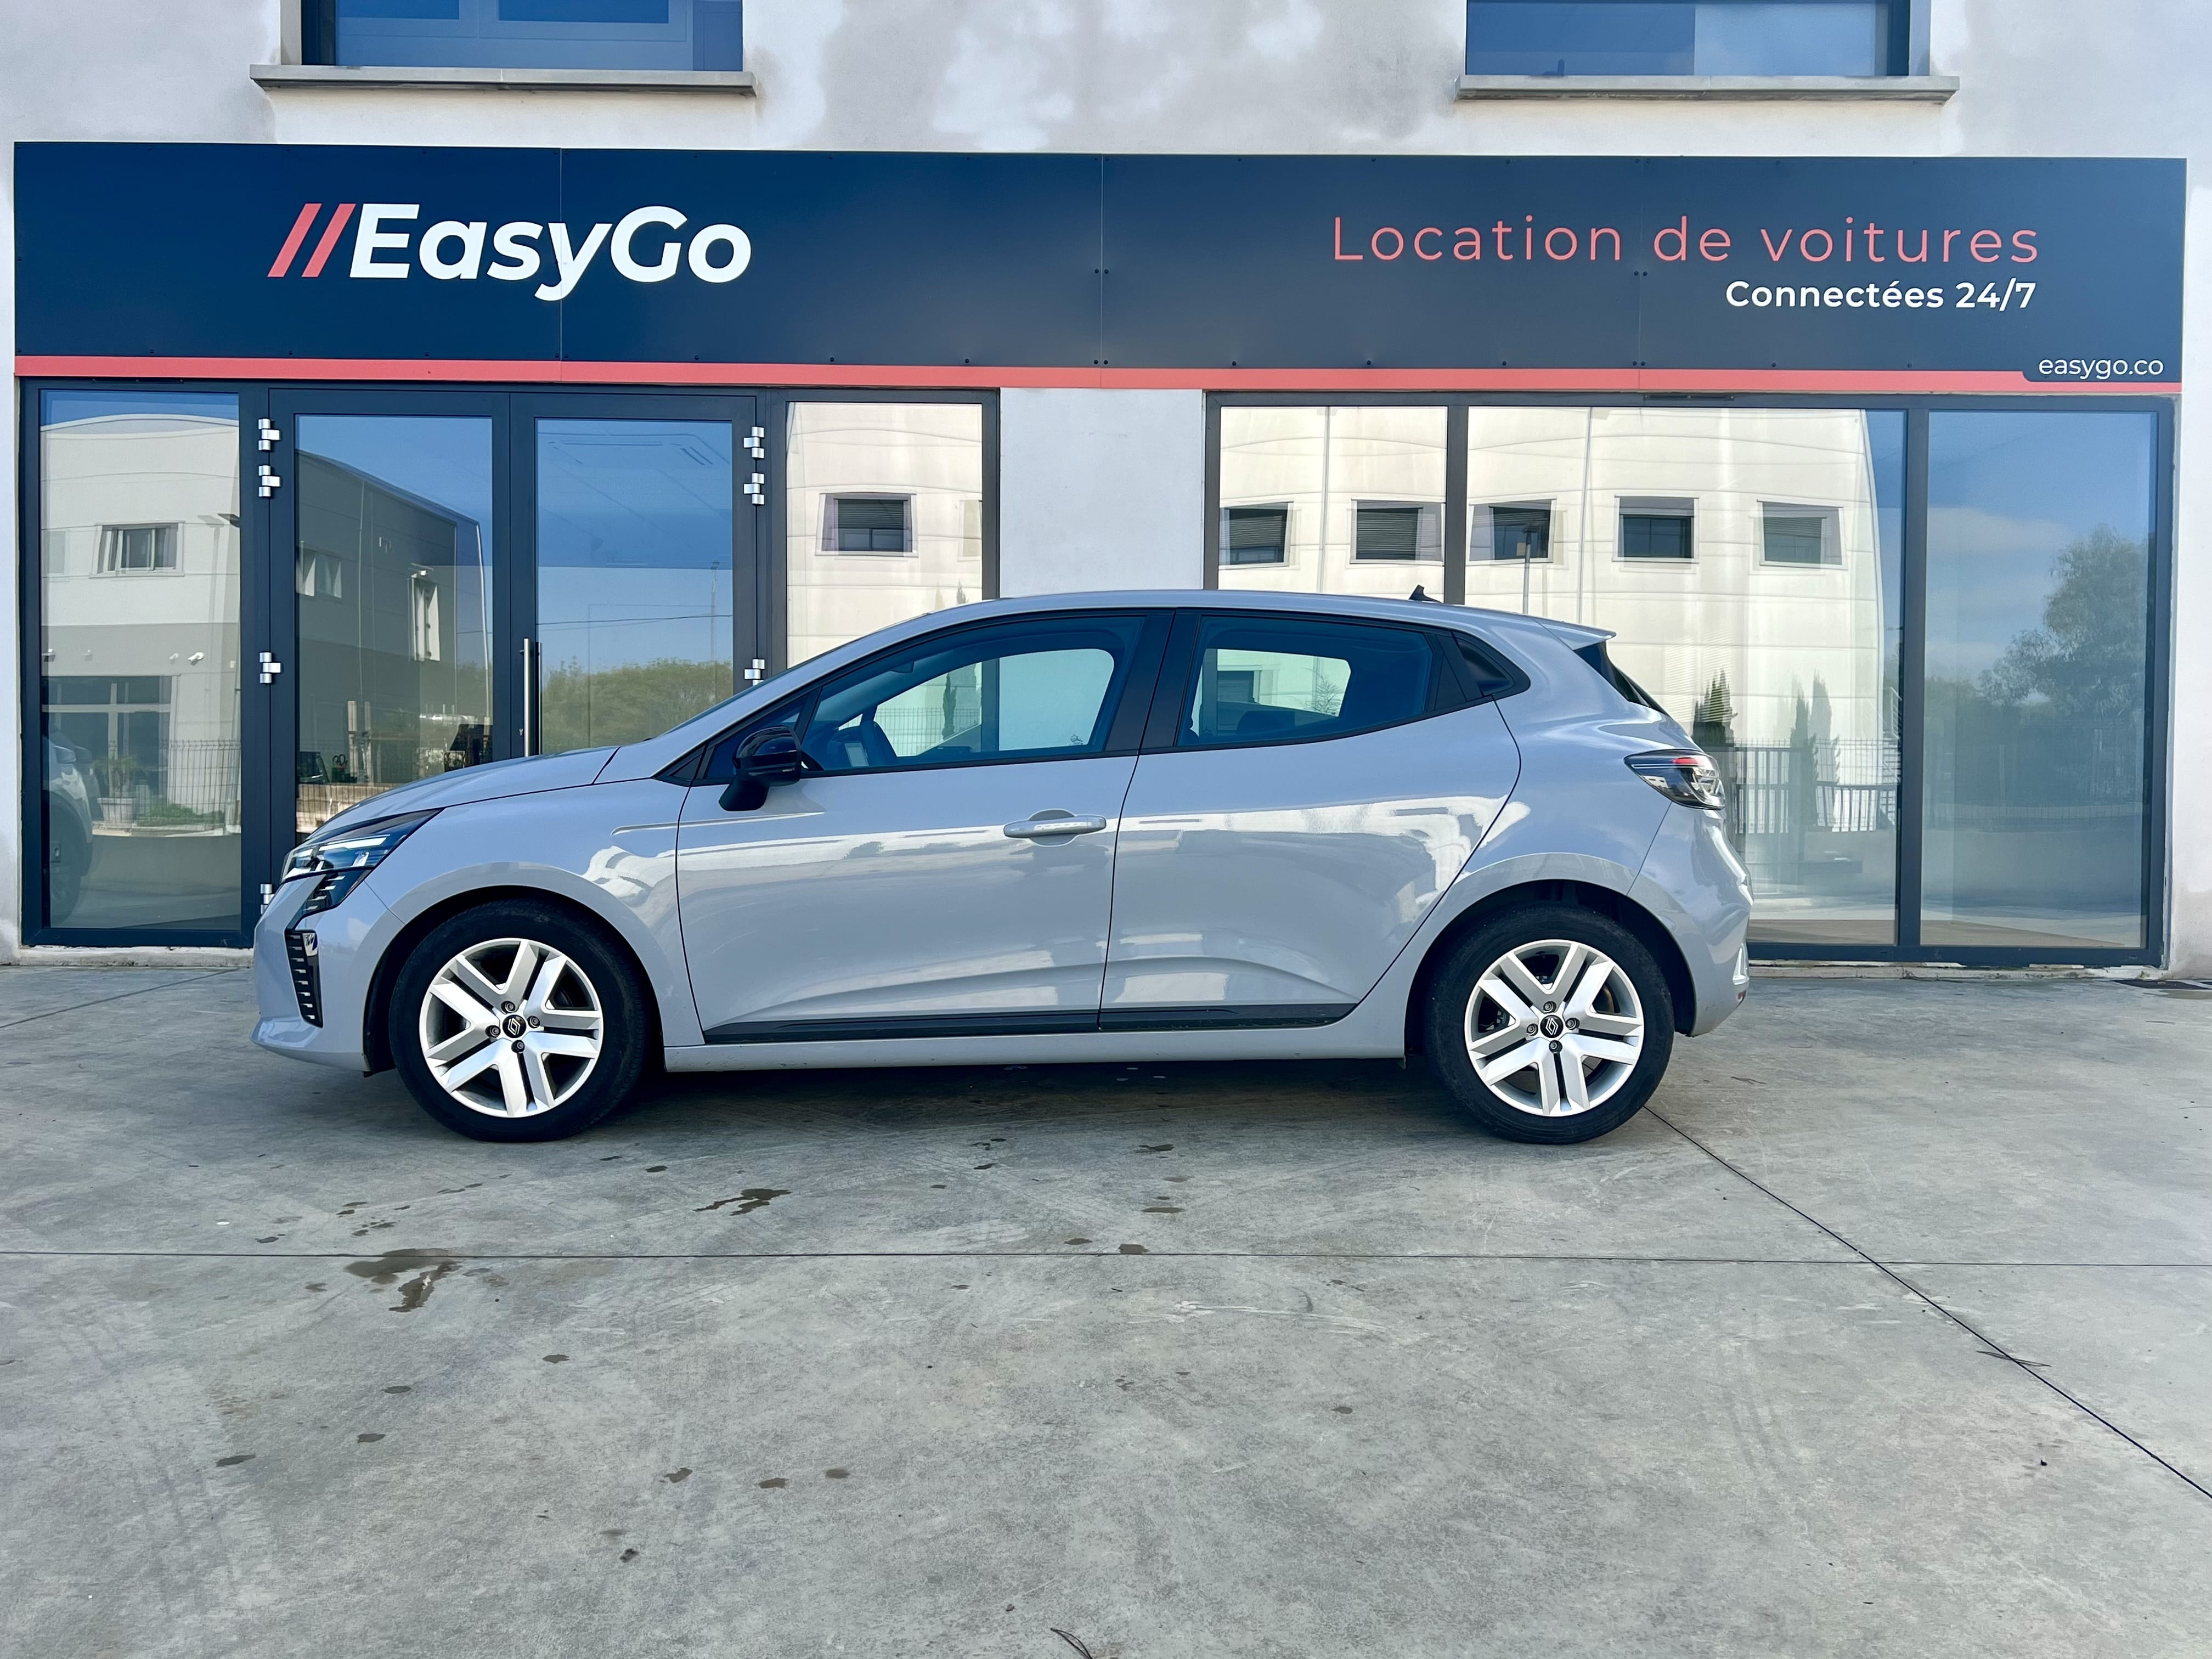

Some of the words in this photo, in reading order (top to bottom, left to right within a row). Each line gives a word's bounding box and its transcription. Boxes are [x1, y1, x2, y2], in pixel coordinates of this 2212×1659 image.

[1334, 215, 1621, 261] Location
[1654, 216, 1731, 262] de
[1760, 216, 2038, 263] voitures
[1725, 280, 1944, 308] Connectées
[1956, 278, 2036, 312] 24/7
[2038, 359, 2164, 380] easygo.co
